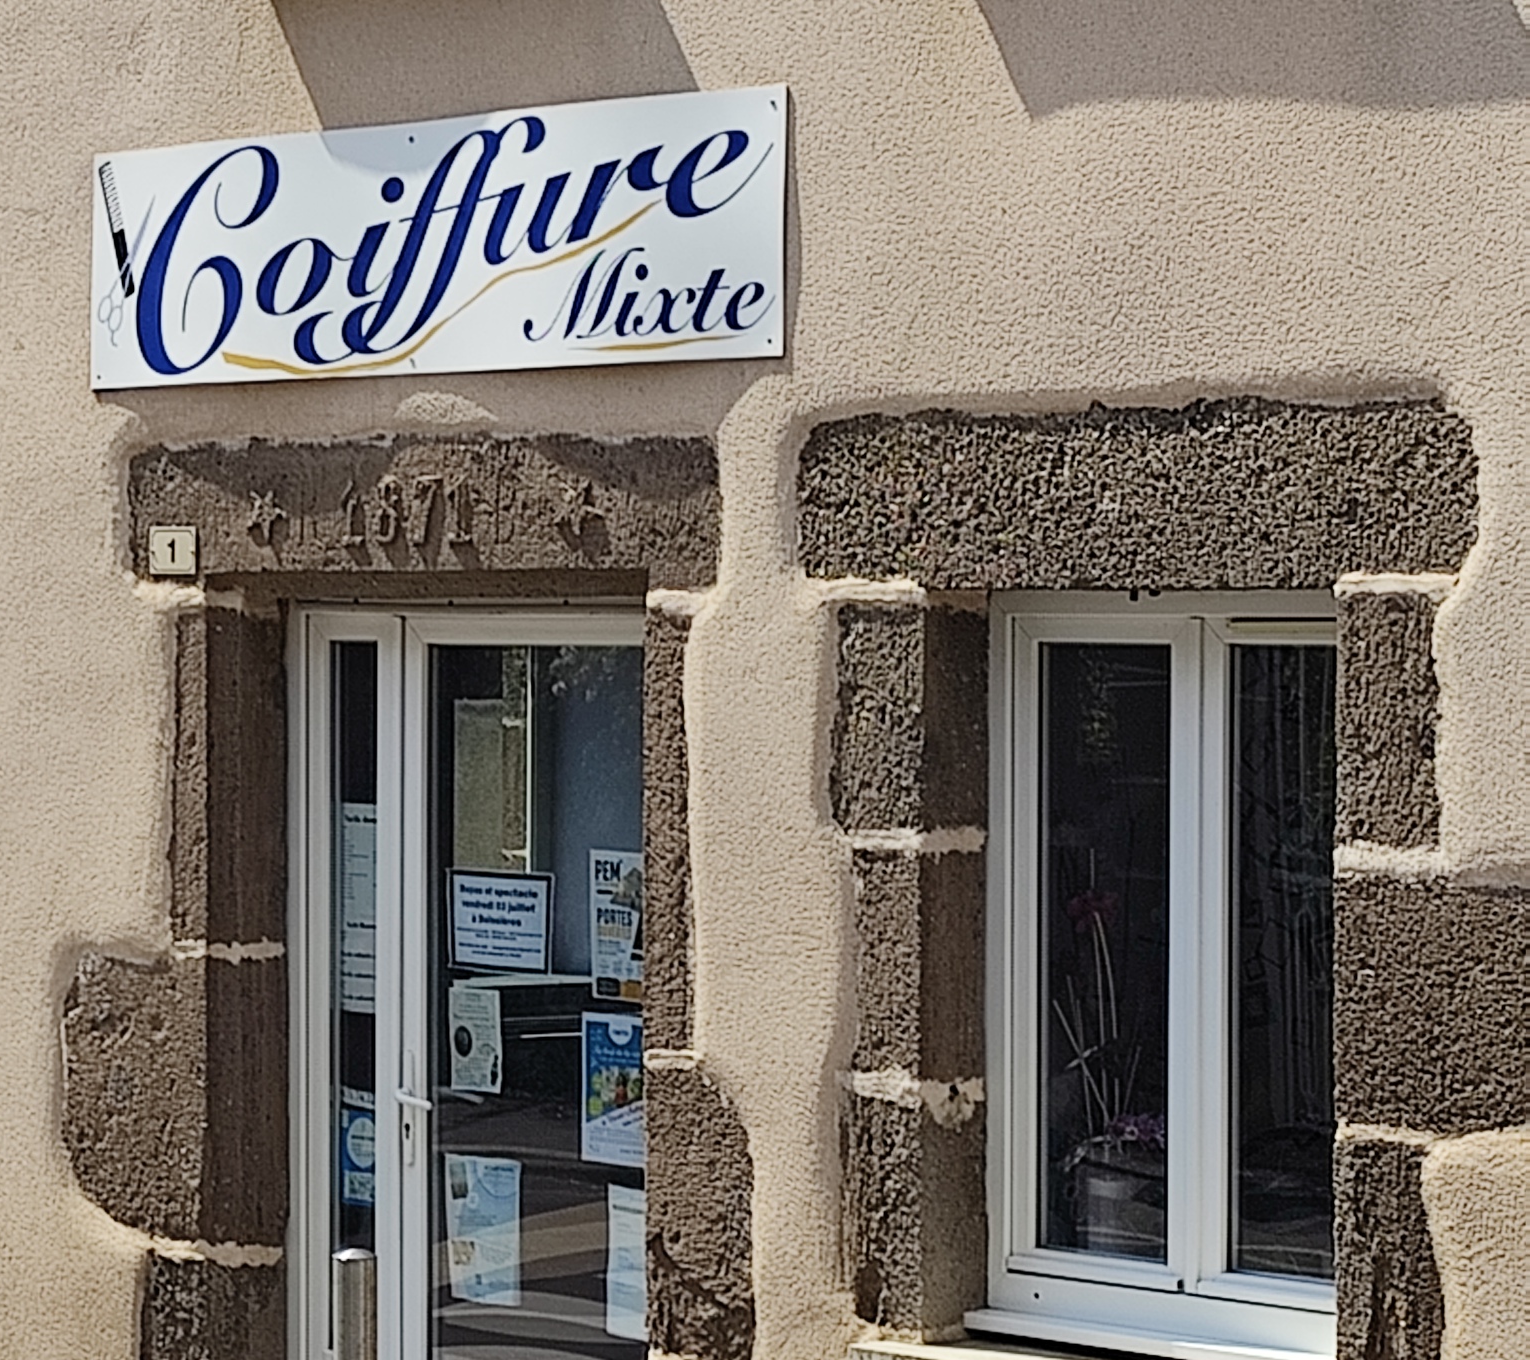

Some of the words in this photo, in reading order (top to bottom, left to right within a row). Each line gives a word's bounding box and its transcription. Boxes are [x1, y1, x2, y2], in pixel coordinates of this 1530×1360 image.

[134, 114, 774, 376] Coiffure
[524, 246, 773, 339] Mixte
[341, 474, 471, 546] 1871
[166, 538, 178, 564] 1
[597, 907, 633, 927] PORTES
